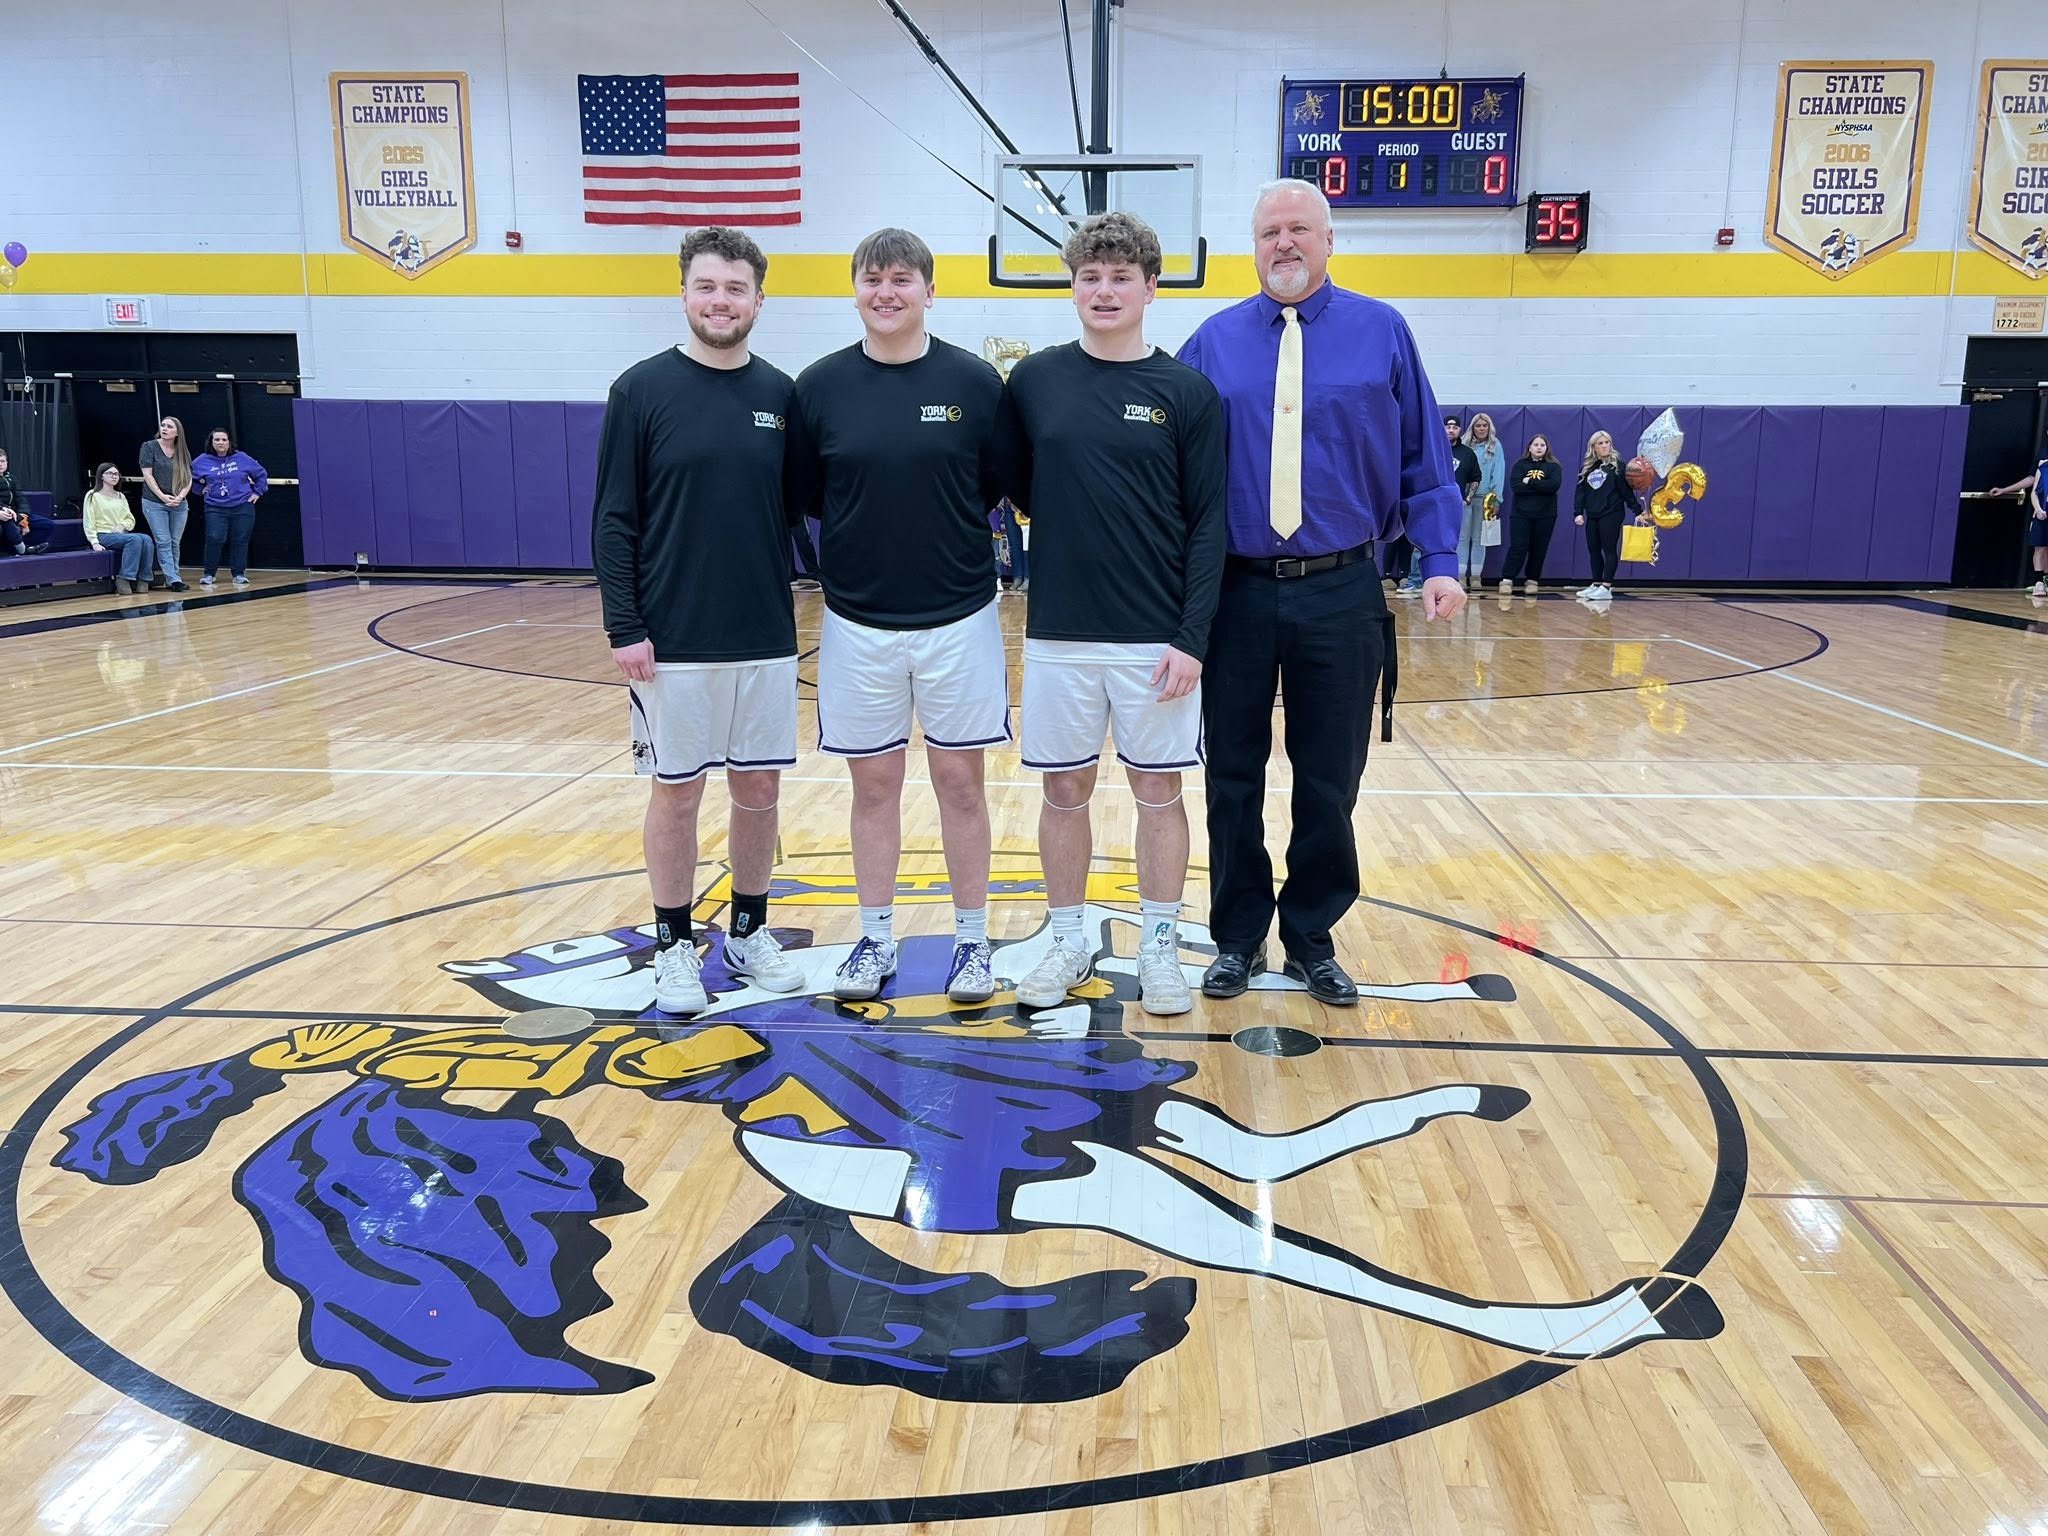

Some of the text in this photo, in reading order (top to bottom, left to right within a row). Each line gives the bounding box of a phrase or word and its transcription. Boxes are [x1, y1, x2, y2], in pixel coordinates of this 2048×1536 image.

[1825, 75, 1885, 93] STATE
[372, 86, 425, 103] STATE
[1362, 85, 1455, 124] 15:00
[1799, 96, 1906, 115] CHAMPIONS
[352, 106, 448, 124] CHAMPIONS
[1834, 123, 1873, 132] NYSPHSAA
[1298, 133, 1342, 151] YORK
[1378, 143, 1419, 156] PERIOD
[1451, 132, 1507, 151] GUEST
[382, 146, 424, 164] 2025
[1824, 143, 1871, 163] 2006
[381, 171, 428, 187] GIRLS
[1813, 168, 1879, 190] GIRLS
[355, 190, 457, 207] VOLLEYBALL
[1801, 193, 1885, 215] SOCCER
[1536, 202, 1581, 241] 35
[116, 304, 134, 318] EXIT
[1996, 319, 2019, 328] 1772
[752, 411, 775, 422] YORK
[920, 405, 947, 416] YORK
[1125, 404, 1152, 415] YORK
